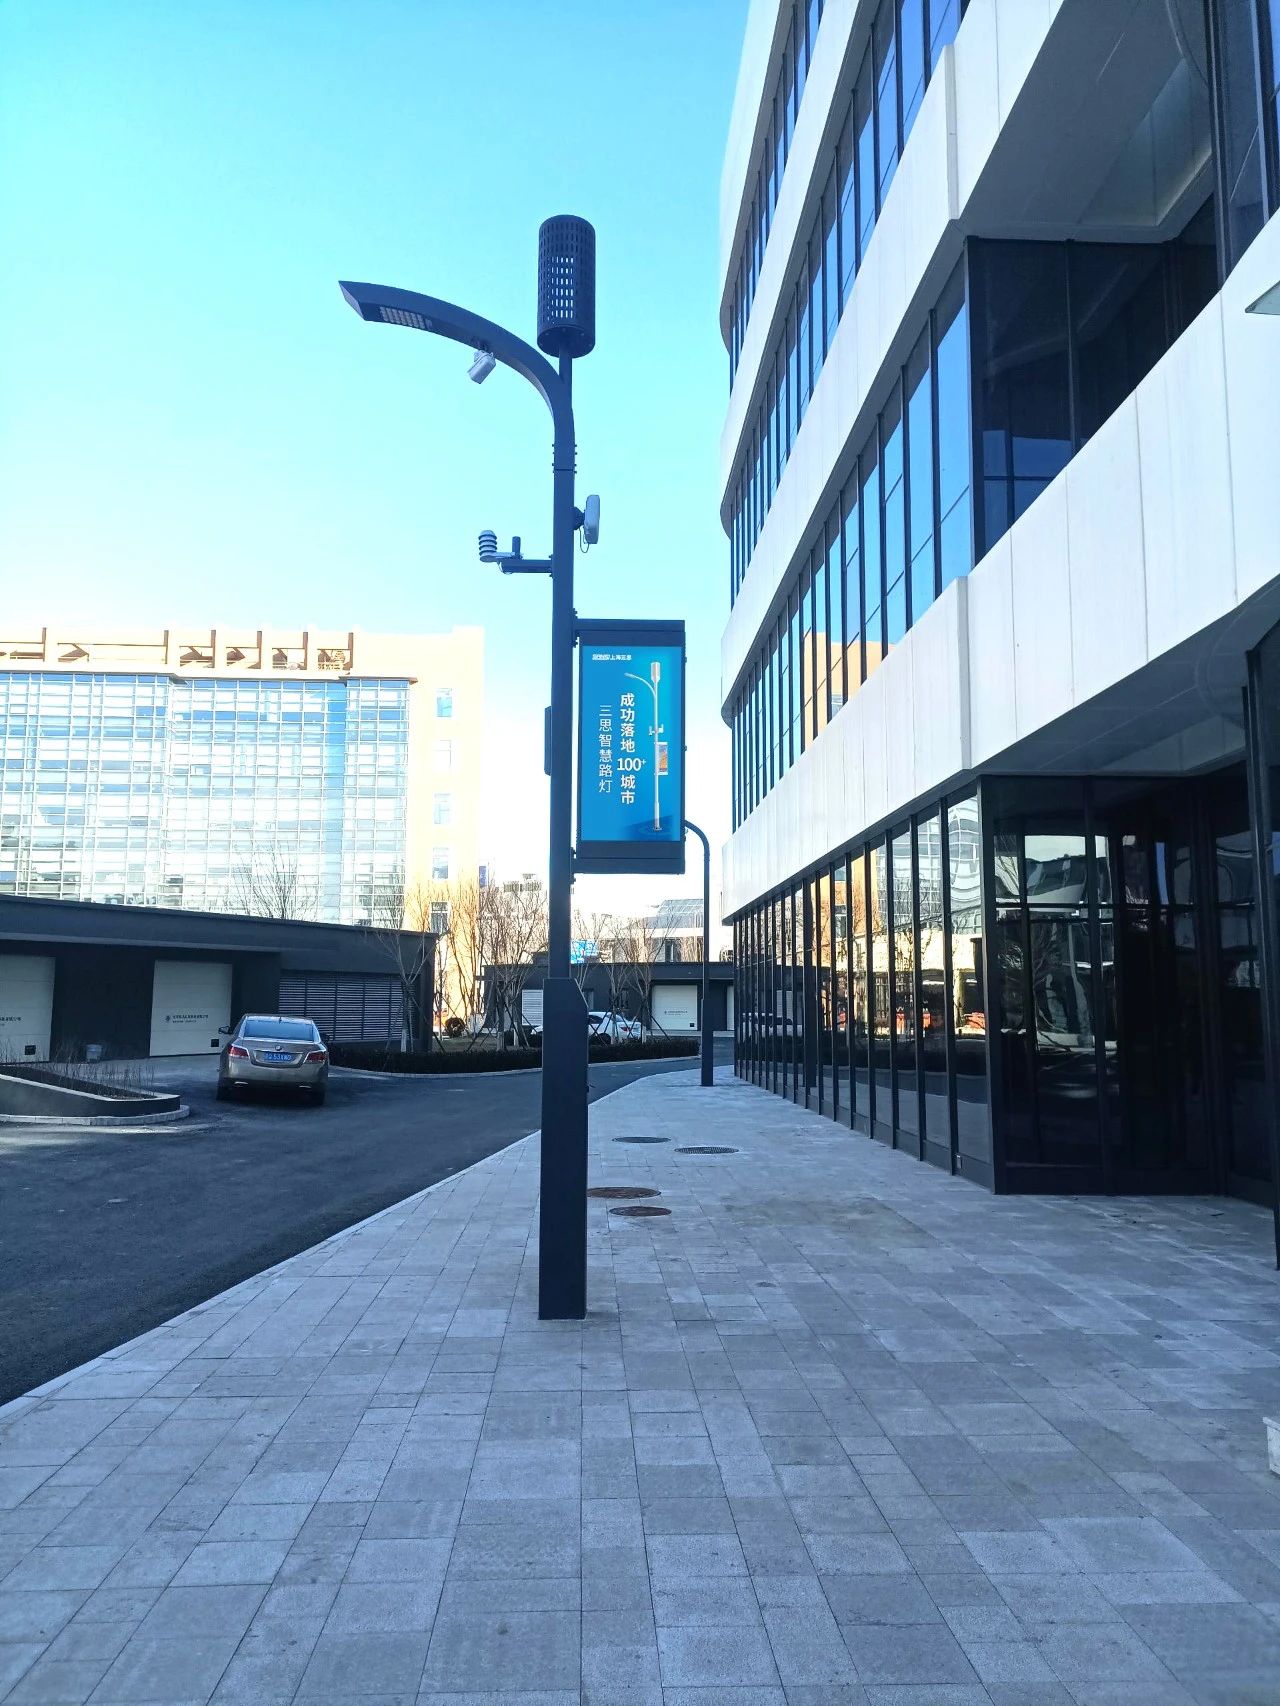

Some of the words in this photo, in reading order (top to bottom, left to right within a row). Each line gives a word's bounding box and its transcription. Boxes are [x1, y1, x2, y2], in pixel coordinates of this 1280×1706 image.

[598, 704, 613, 794] 三思智慧路灯
